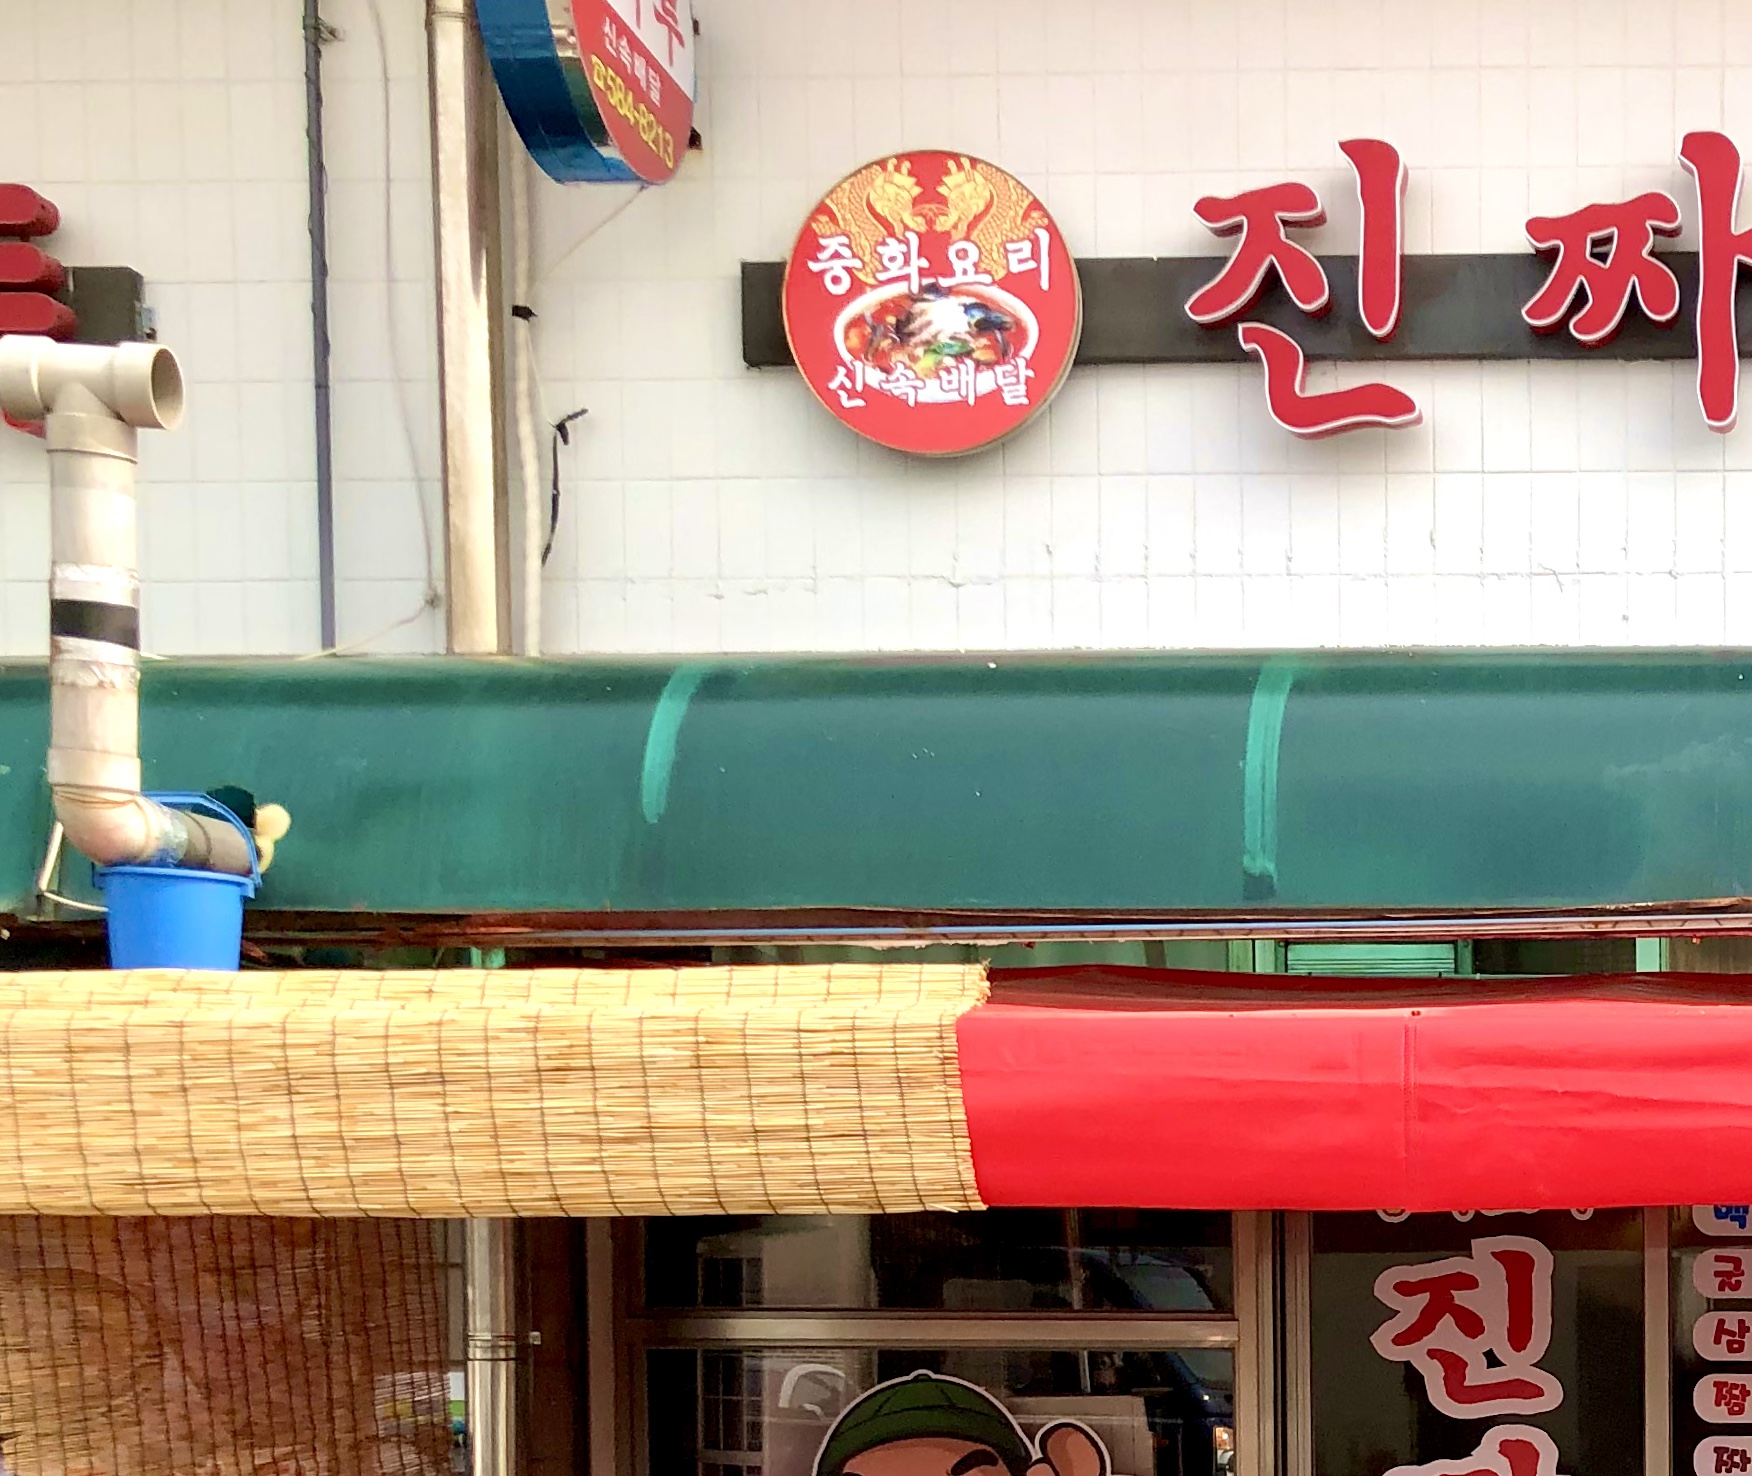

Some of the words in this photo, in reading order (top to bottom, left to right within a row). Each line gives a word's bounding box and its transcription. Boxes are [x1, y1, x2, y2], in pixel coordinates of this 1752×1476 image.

[606, 65, 674, 169] 584-8213
[806, 228, 1051, 296] 중화요리
[827, 357, 1036, 410] 신속배달
